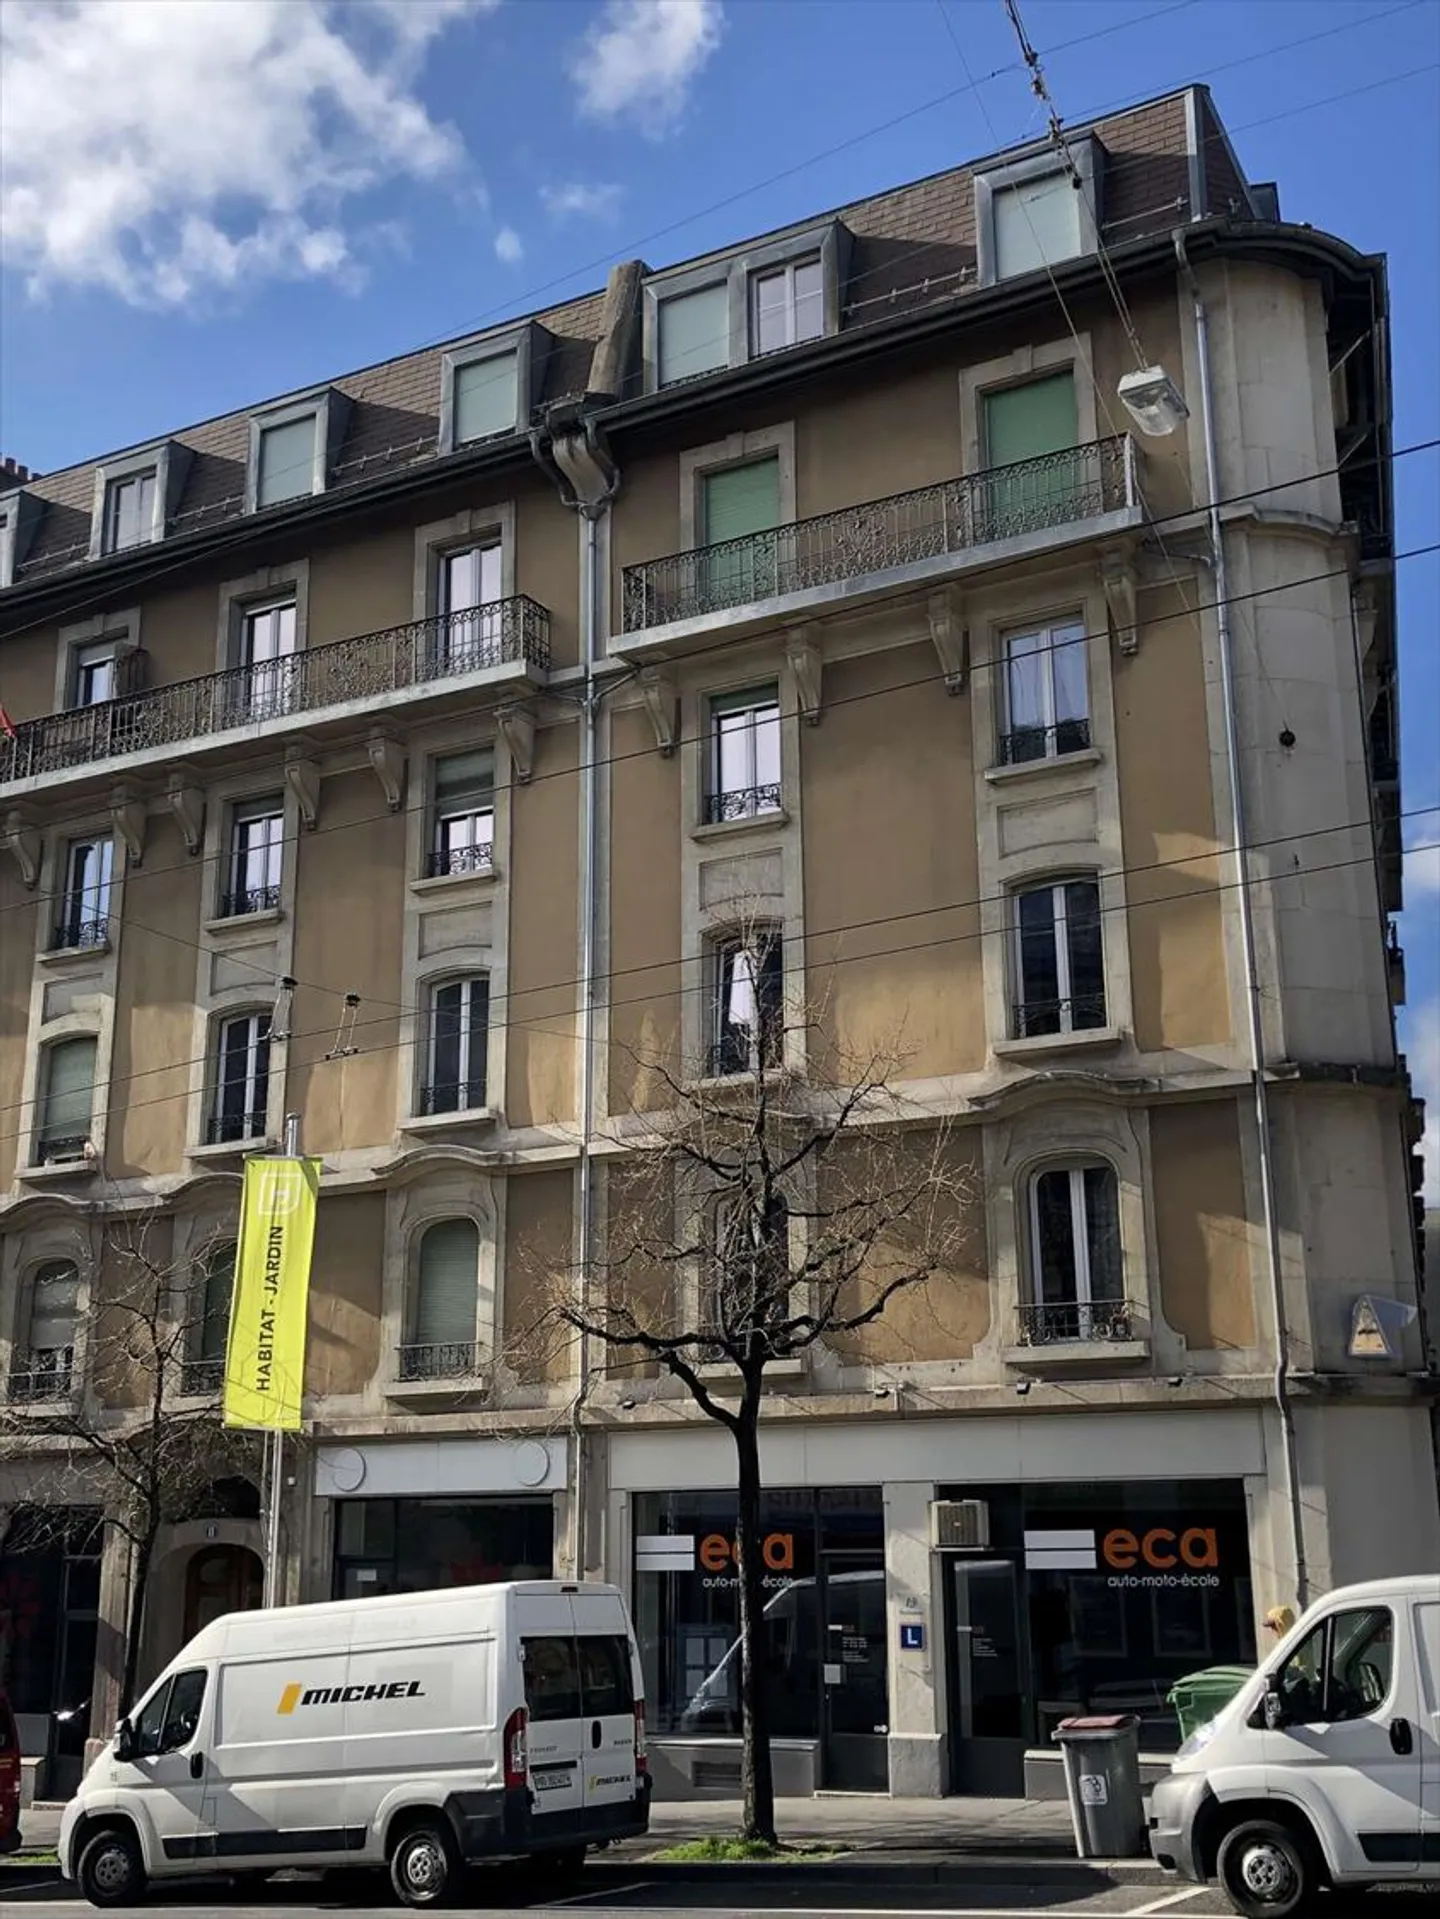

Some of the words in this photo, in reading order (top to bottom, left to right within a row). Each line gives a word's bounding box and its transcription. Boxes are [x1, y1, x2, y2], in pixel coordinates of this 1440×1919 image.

[1103, 1528, 1218, 1569] eca
[1107, 1574, 1220, 1588] auto-moto-école
[907, 1627, 918, 1645] L
[301, 1681, 426, 1705] MICHEL
